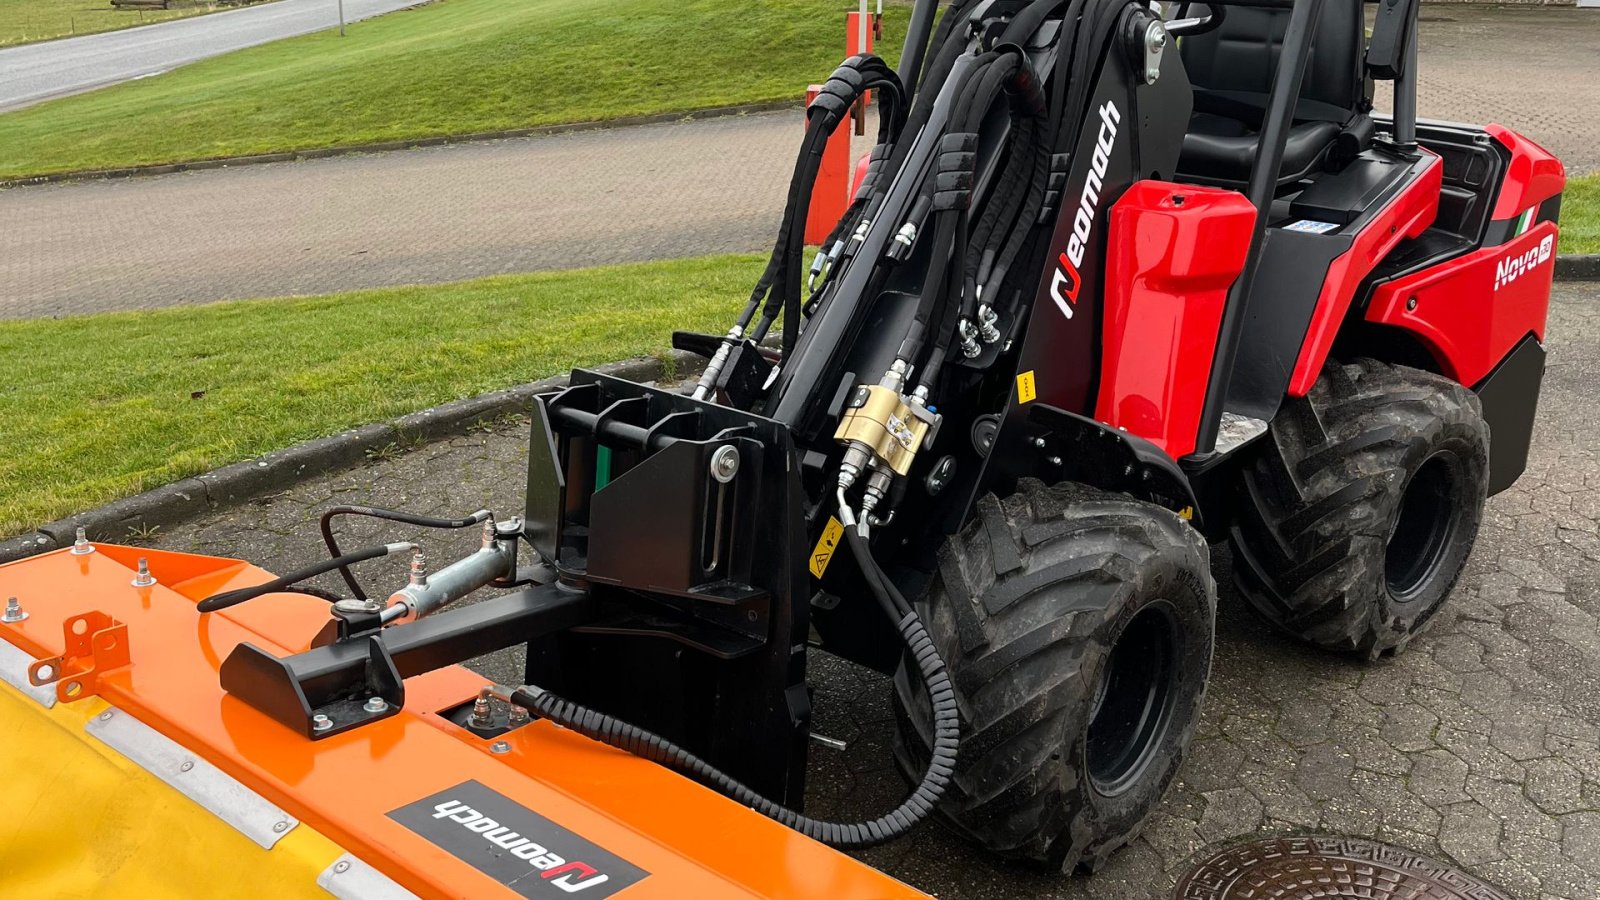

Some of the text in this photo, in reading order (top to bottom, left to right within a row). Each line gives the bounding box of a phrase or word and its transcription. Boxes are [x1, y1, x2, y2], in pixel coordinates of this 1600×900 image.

[1050, 100, 1121, 319] Neomach
[1494, 246, 1539, 291] Nova
[431, 800, 609, 893] Neomach
